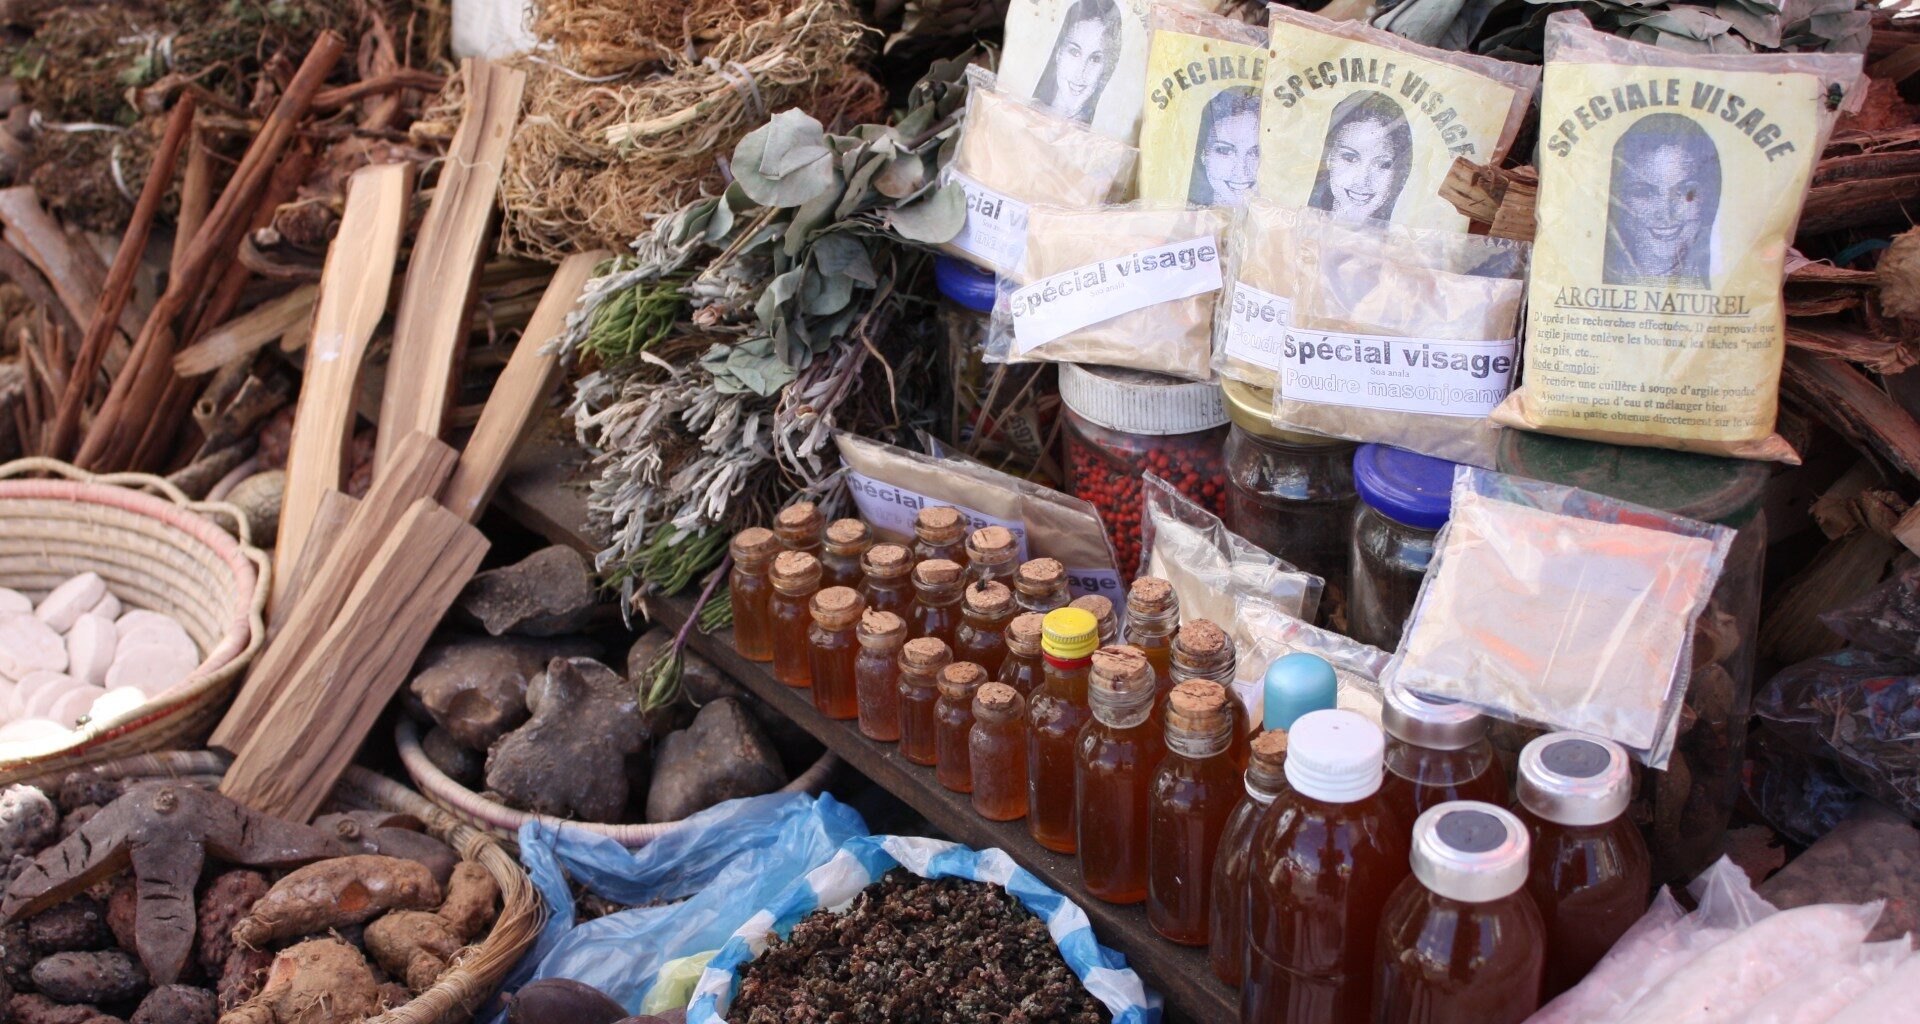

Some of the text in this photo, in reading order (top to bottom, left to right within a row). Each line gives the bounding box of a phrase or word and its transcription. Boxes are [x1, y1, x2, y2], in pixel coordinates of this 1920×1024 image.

[1150, 55, 1265, 110] SPECIALE
[1273, 57, 1476, 159] SPECIALE VISAGE
[1547, 78, 1795, 162] SPECIALE VISAGE
[1012, 245, 1216, 318] Spécial visage
[1554, 286, 1750, 315] ARGILE NATUREL
[1562, 329, 1588, 342] jaune
[1627, 333, 1641, 345] les
[1690, 337, 1704, 348] les
[1567, 313, 1580, 325] les
[1582, 316, 1636, 328] recherches
[1706, 325, 1721, 334] est
[1723, 323, 1757, 336] prouvé
[1760, 325, 1776, 335] que
[1283, 334, 1511, 379] Spécial visage
[1539, 343, 1551, 354] les
[1370, 367, 1410, 378] Soa anala
[1541, 374, 1576, 388] Prendre
[1578, 380, 1596, 389] une
[1648, 383, 1677, 396] soupe
[1286, 368, 1508, 407] Poudre masonjoany
[1577, 395, 1589, 404] un
[1592, 397, 1611, 407] peu
[1644, 400, 1654, 408] et
[1656, 401, 1703, 413] mélanger
[1611, 411, 1651, 422] obtenue
[1652, 413, 1712, 426] directement
[1714, 418, 1730, 427] sur
[847, 475, 924, 511] pécial
